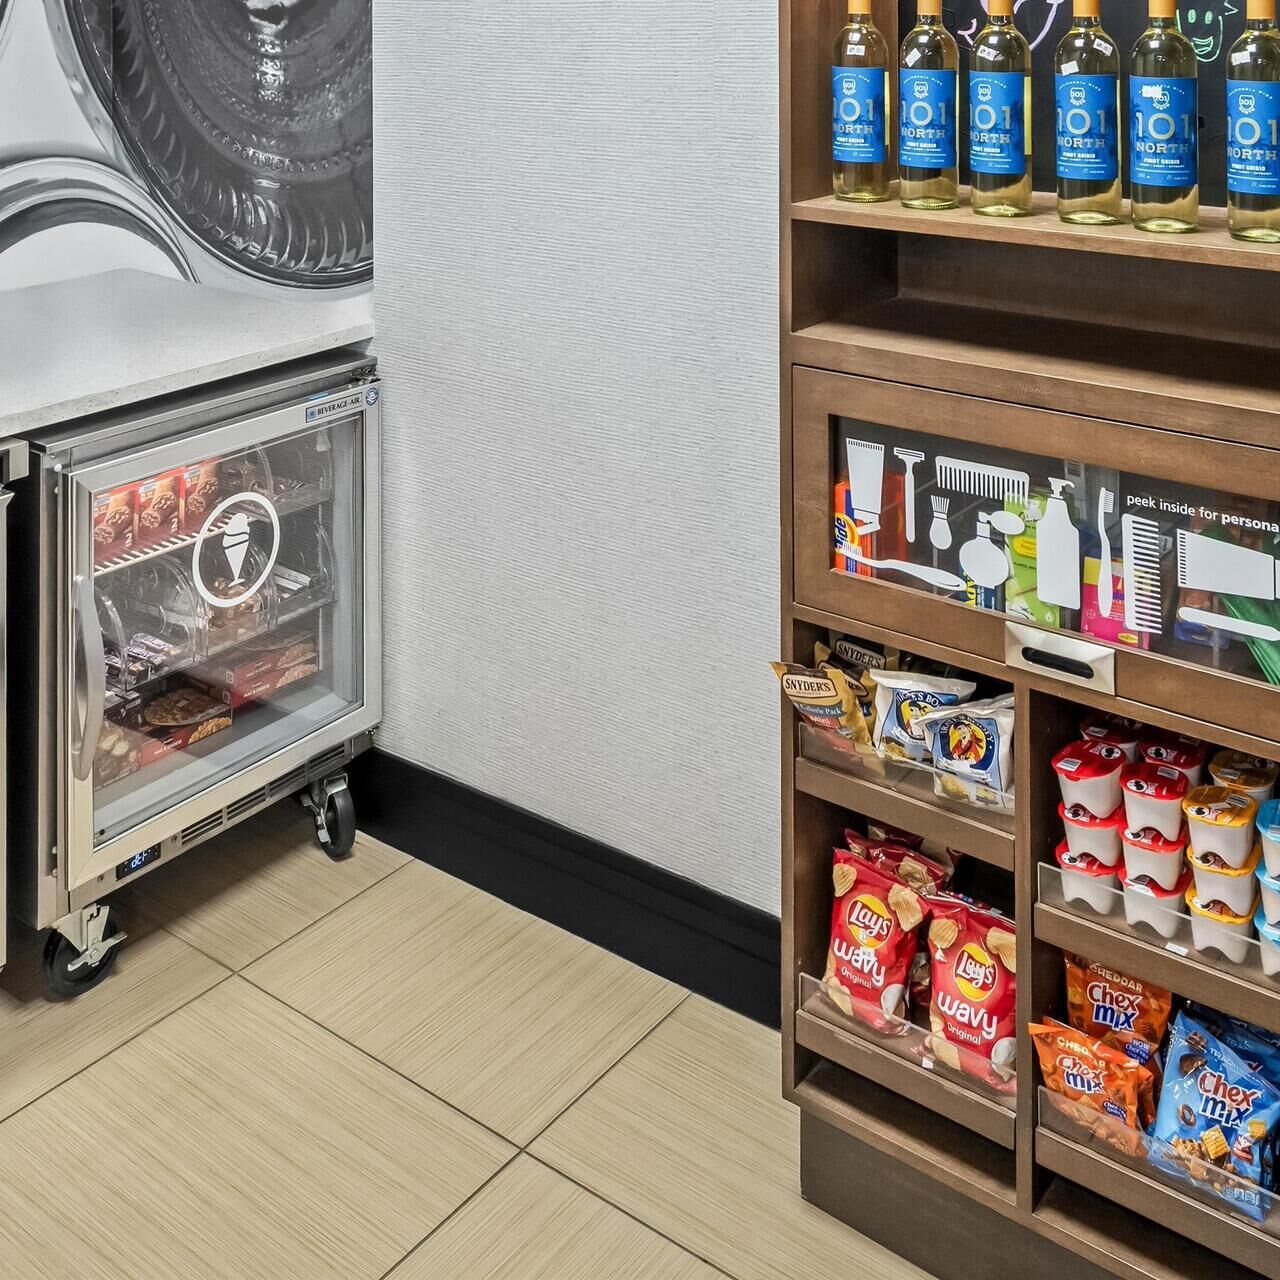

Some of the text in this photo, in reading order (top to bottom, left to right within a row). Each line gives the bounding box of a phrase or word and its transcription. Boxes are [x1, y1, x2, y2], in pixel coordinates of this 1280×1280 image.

[901, 100, 946, 126] 101
[1056, 107, 1106, 135] 101
[1135, 111, 1189, 140] 101
[1057, 137, 1106, 148] NORTH
[1227, 116, 1278, 146] 101
[1135, 141, 1189, 154] NORTH
[317, 396, 360, 416] BEVERAGE-AIR
[1126, 493, 1156, 509] peek
[1159, 499, 1196, 517] inside
[1199, 506, 1219, 521] for
[838, 643, 881, 669] SNYDER'S
[785, 677, 831, 692] SNYDER'S
[850, 901, 891, 937] Lay's
[833, 937, 886, 987] wavy
[956, 956, 995, 989] Lay's
[841, 966, 872, 988] Original
[1089, 963, 1143, 993] CHEDDAR
[1087, 982, 1140, 1012] Chex
[937, 991, 998, 1040] wavy
[1093, 1005, 1137, 1030] mix
[947, 1021, 982, 1046] Original
[1065, 1071, 1104, 1094] mix
[1198, 1071, 1260, 1108] Chex
[1200, 1095, 1250, 1128] mix
